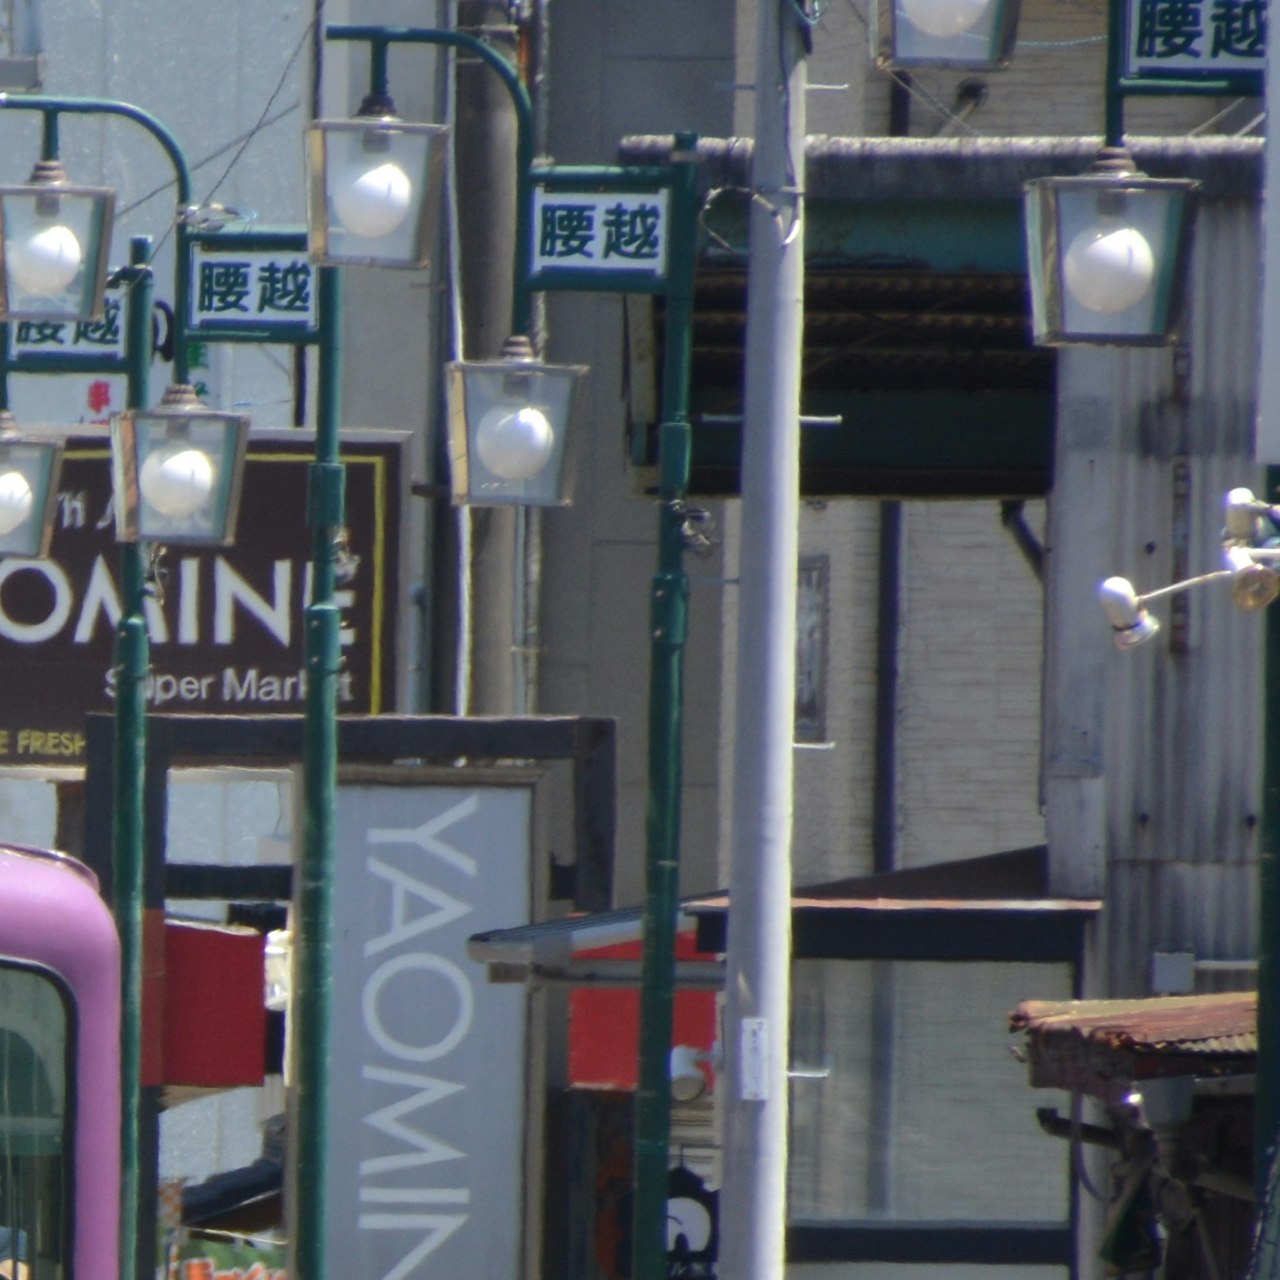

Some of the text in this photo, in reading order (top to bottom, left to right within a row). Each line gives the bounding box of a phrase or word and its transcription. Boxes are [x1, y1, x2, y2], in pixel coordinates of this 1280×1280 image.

[1137, 0, 1268, 59] 腰越
[539, 202, 661, 260] 腰越
[198, 260, 311, 314] 腰越
[222, 667, 354, 702] Mart
